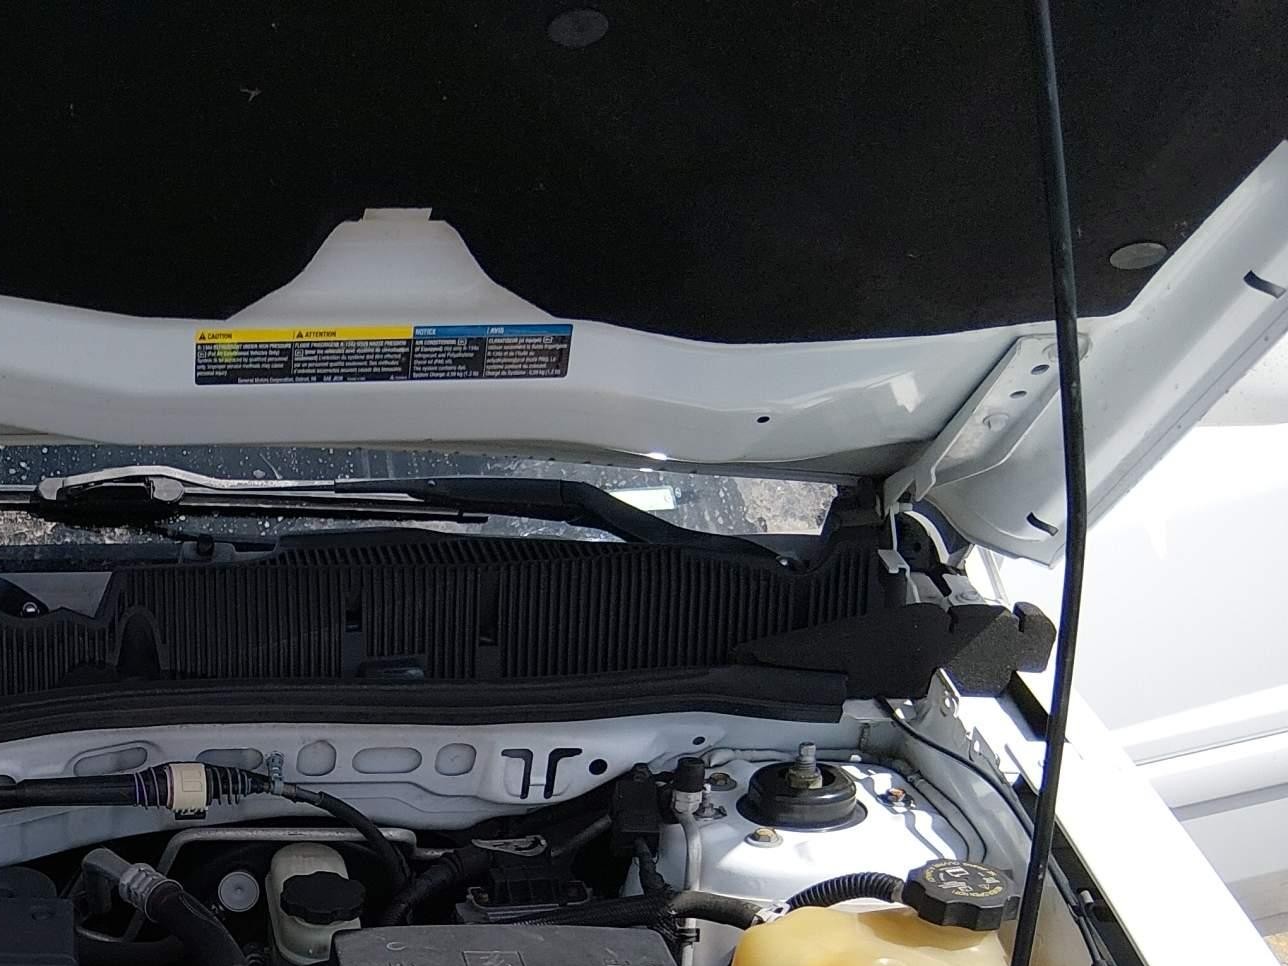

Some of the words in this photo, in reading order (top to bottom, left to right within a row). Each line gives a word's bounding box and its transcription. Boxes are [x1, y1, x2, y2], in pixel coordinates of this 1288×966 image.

[304, 330, 337, 338] ATTENTION
[415, 328, 437, 336] NOTICE
[490, 327, 505, 335] AVIS
[207, 332, 233, 340] CAUTION
